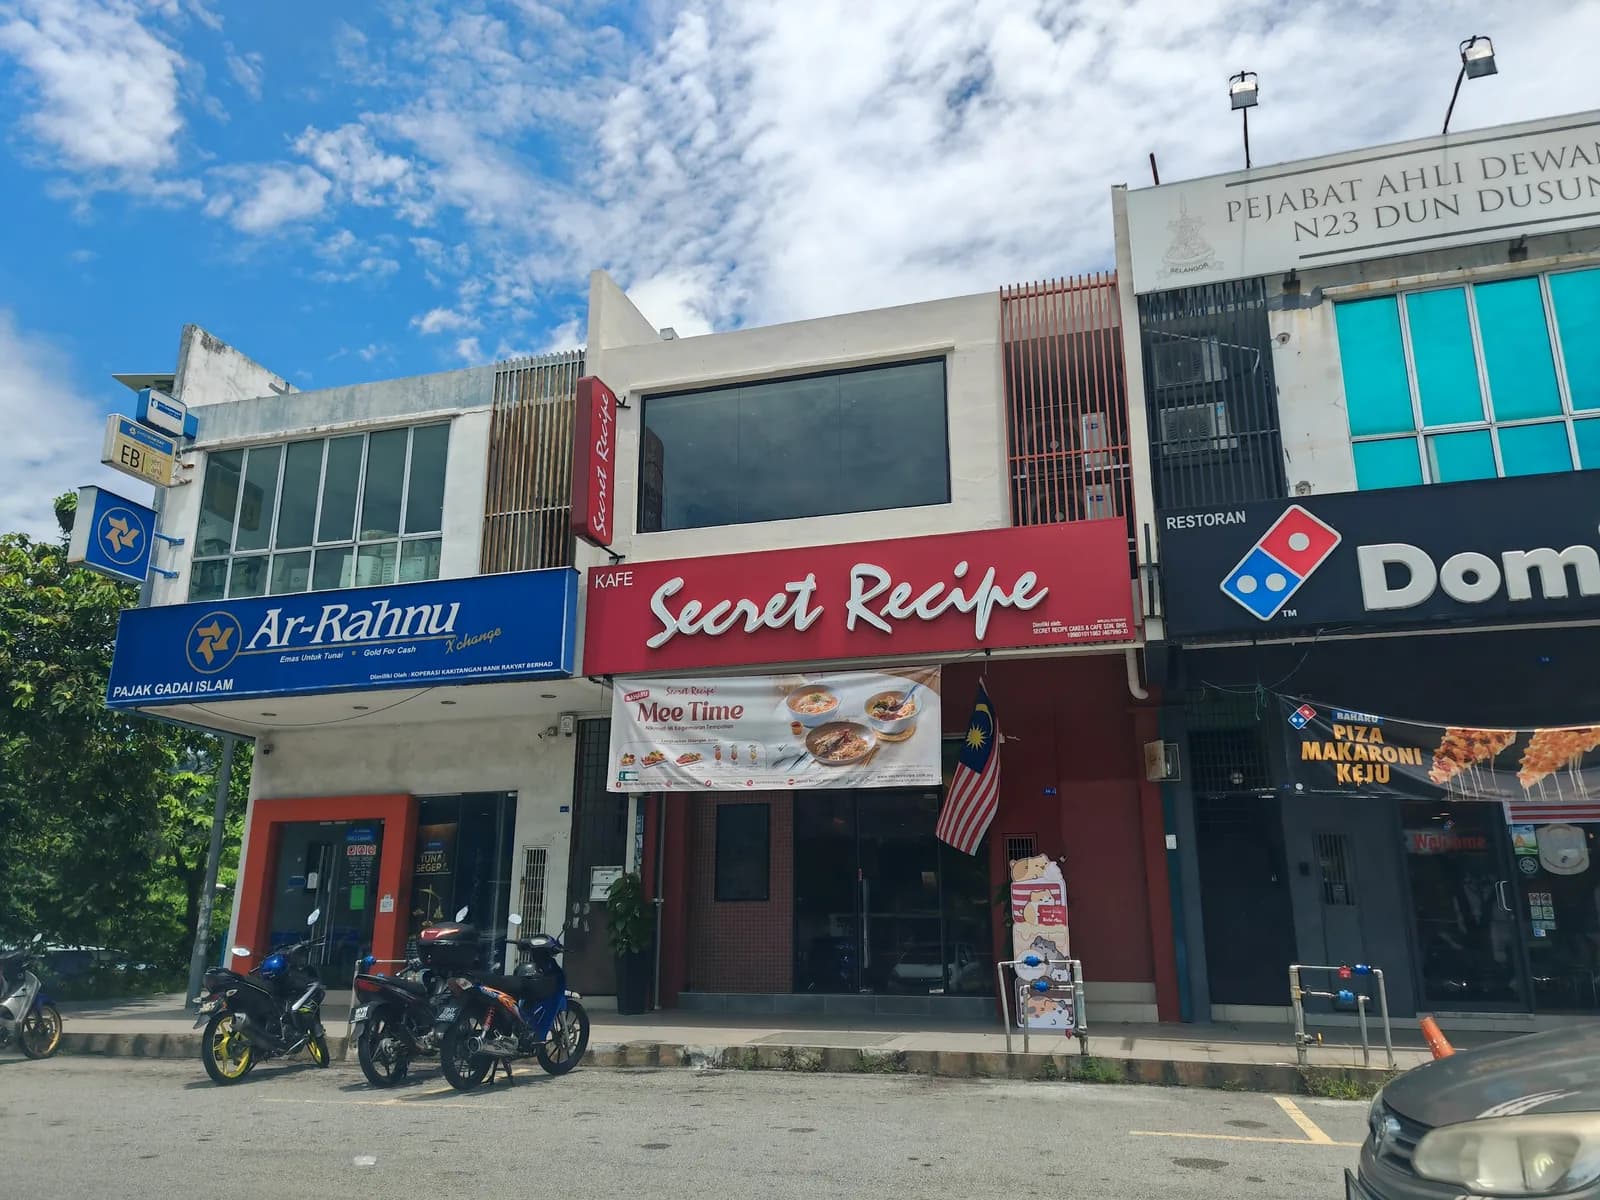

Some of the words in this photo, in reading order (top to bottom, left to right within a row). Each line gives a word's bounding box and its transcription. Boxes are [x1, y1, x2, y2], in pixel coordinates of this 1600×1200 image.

[1226, 178, 1362, 222] PEJABAT
[1377, 162, 1464, 197] AHLI
[1480, 140, 1600, 180] DEWA
[1294, 212, 1359, 242] N23
[1374, 194, 1460, 229] DUN
[1170, 262, 1209, 273] SELANGOR
[596, 392, 613, 462] Recipe
[594, 466, 609, 536] Secret
[1166, 510, 1247, 530] RESTORAN
[595, 571, 633, 589] KAFE
[1356, 542, 1600, 612] Dom
[646, 573, 825, 649] Secret
[846, 560, 1049, 641] Recipe
[1281, 609, 1297, 618] TM
[245, 599, 461, 650] Ar-Rahnu
[280, 655, 299, 663] Emas
[301, 653, 322, 662] Untuk
[324, 651, 343, 660] Tunai
[363, 648, 382, 657] Gold
[383, 647, 397, 655] For
[398, 646, 416, 654] Cash
[411, 669, 441, 677] KOPERASI
[441, 666, 482, 676] KAKITANGAN
[113, 684, 151, 698] PAJAK
[154, 681, 193, 695] GADAI
[195, 679, 234, 692] ISLAM
[637, 702, 683, 723] Mee
[688, 701, 744, 721] Time
[1336, 711, 1378, 723] BAHARU
[1332, 724, 1384, 745] PIZA
[1301, 741, 1423, 766] MAKARONI
[1336, 763, 1391, 787] KEJU
